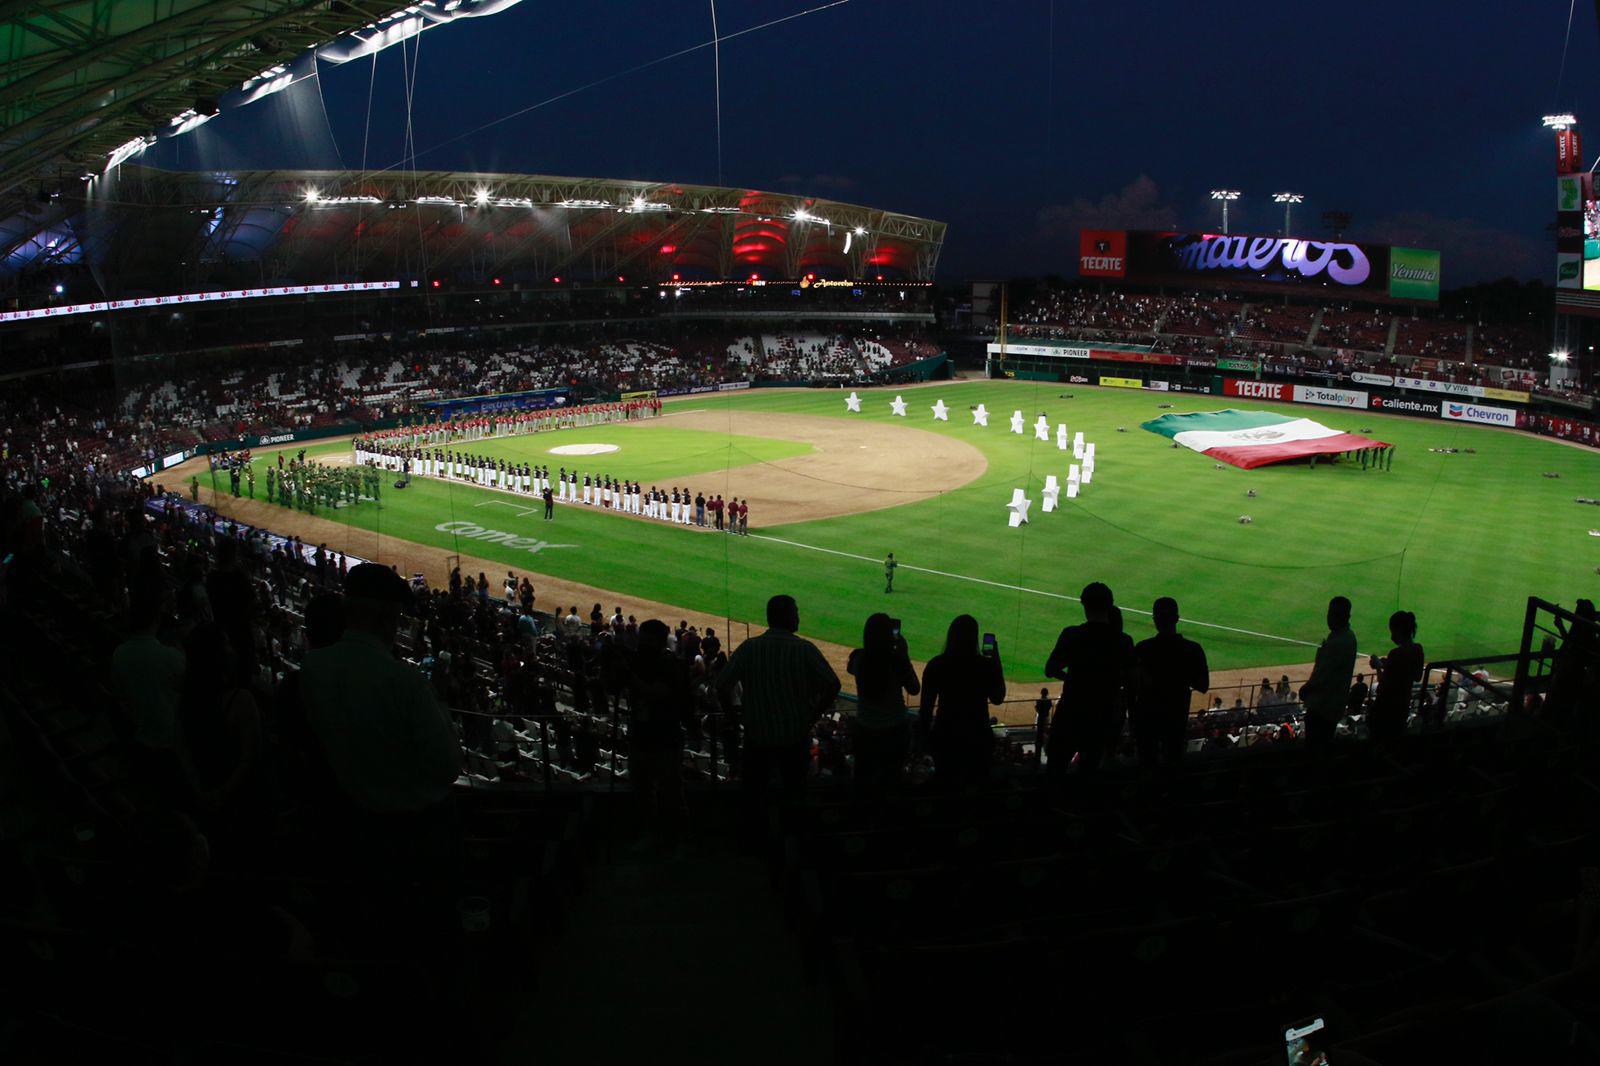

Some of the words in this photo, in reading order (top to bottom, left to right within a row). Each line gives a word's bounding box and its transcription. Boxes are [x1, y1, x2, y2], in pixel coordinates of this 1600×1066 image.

[1081, 256, 1125, 271] TECATE
[1391, 263, 1437, 282] Yemina
[1063, 349, 1088, 357] PIONEER
[1235, 380, 1284, 399] TECATE
[1452, 385, 1469, 393] VIVA
[1316, 391, 1356, 404] Totalplay
[1382, 398, 1438, 413] caliente.mx
[1466, 406, 1509, 422] Chevron
[271, 434, 295, 444] PIONEER
[434, 521, 580, 553] Comex
